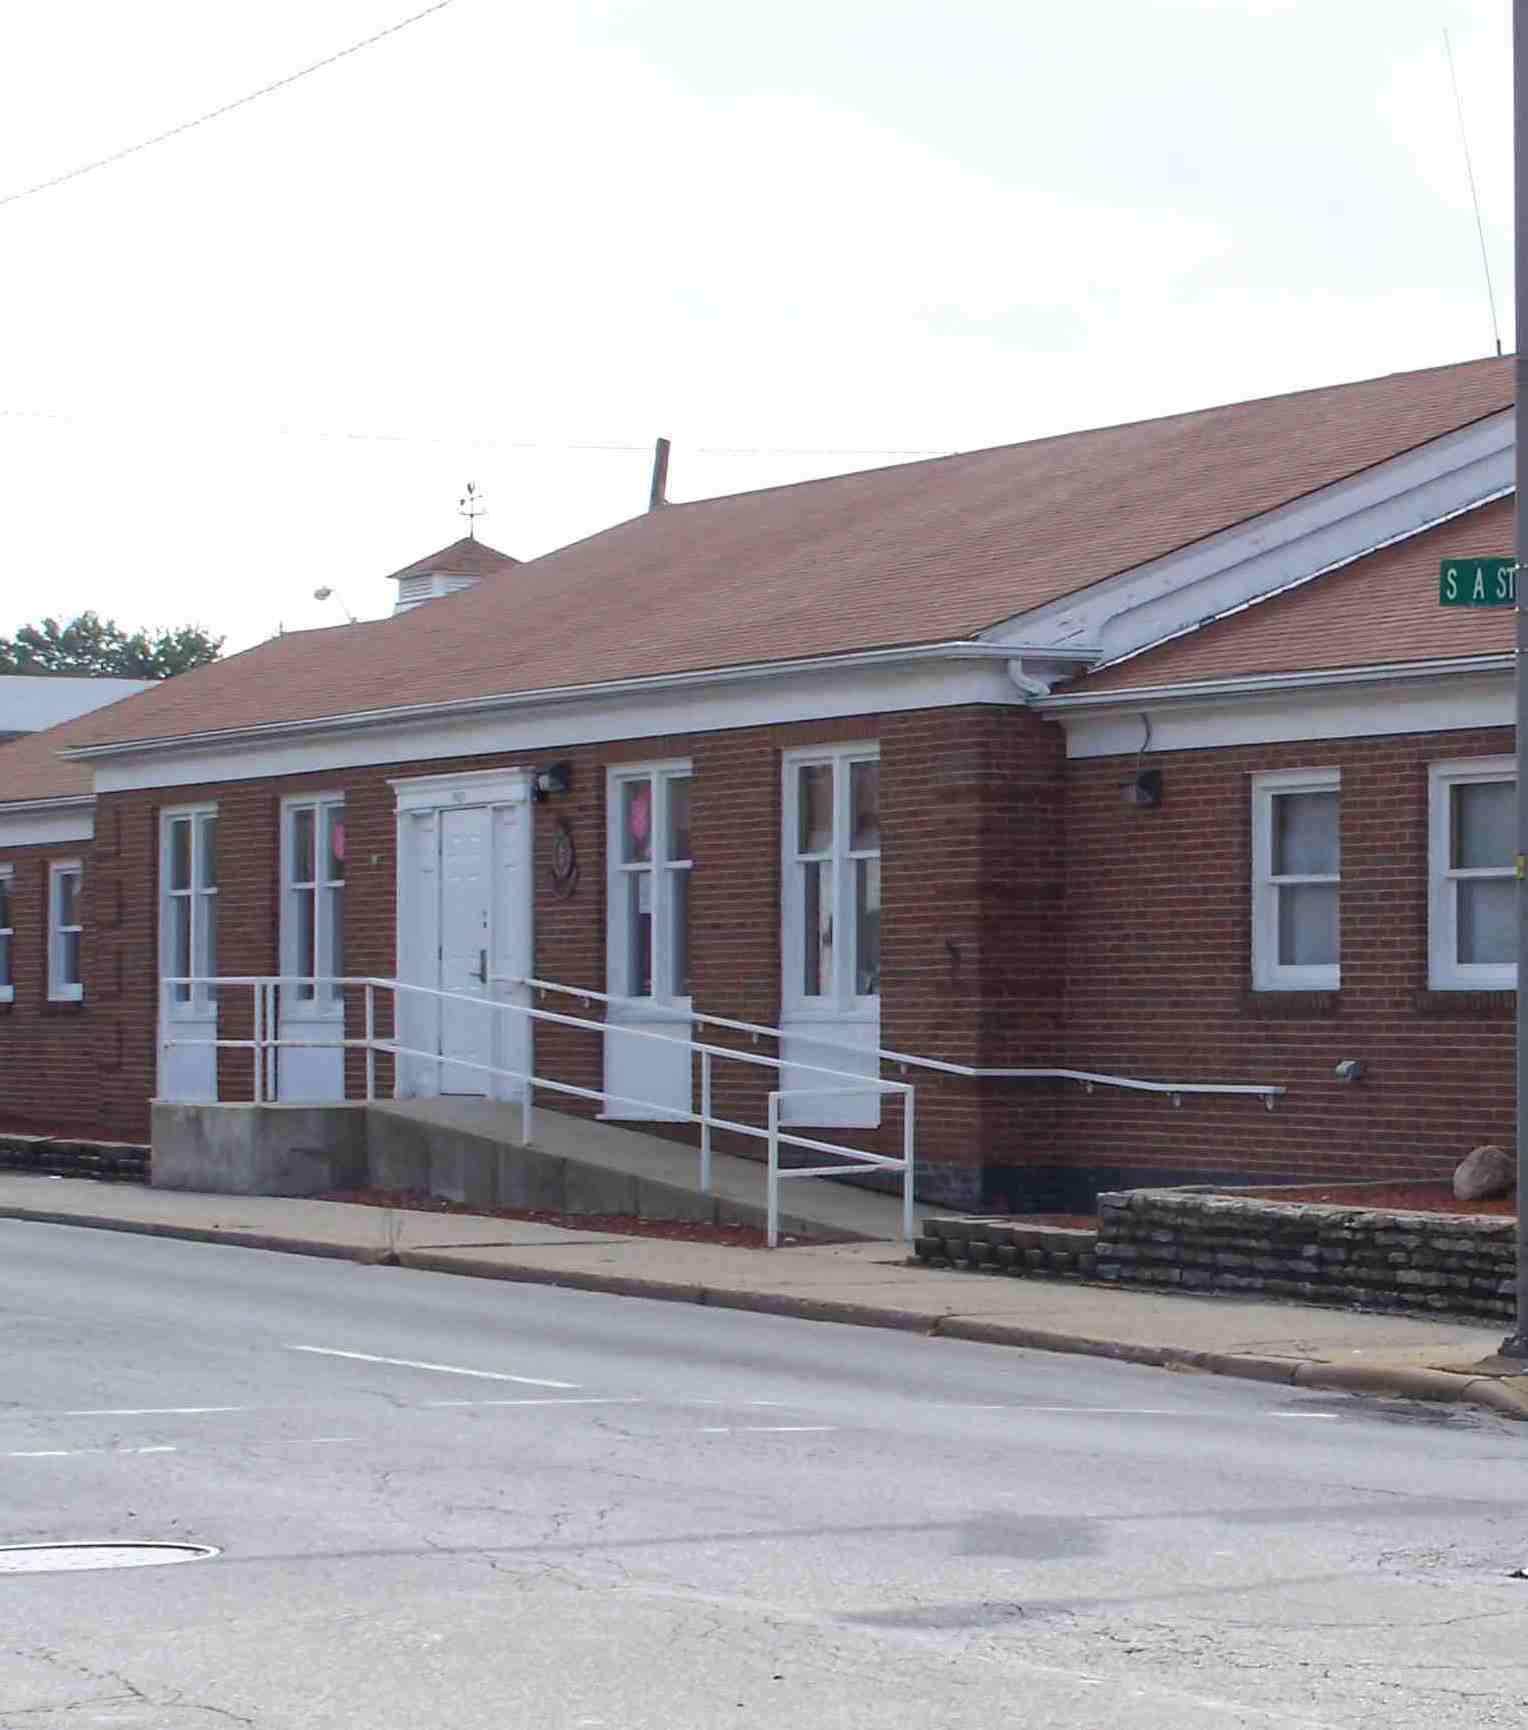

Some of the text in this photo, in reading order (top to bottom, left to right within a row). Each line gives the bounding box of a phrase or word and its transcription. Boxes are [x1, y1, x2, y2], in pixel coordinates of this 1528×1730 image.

[1446, 567, 1517, 600] S A ST
